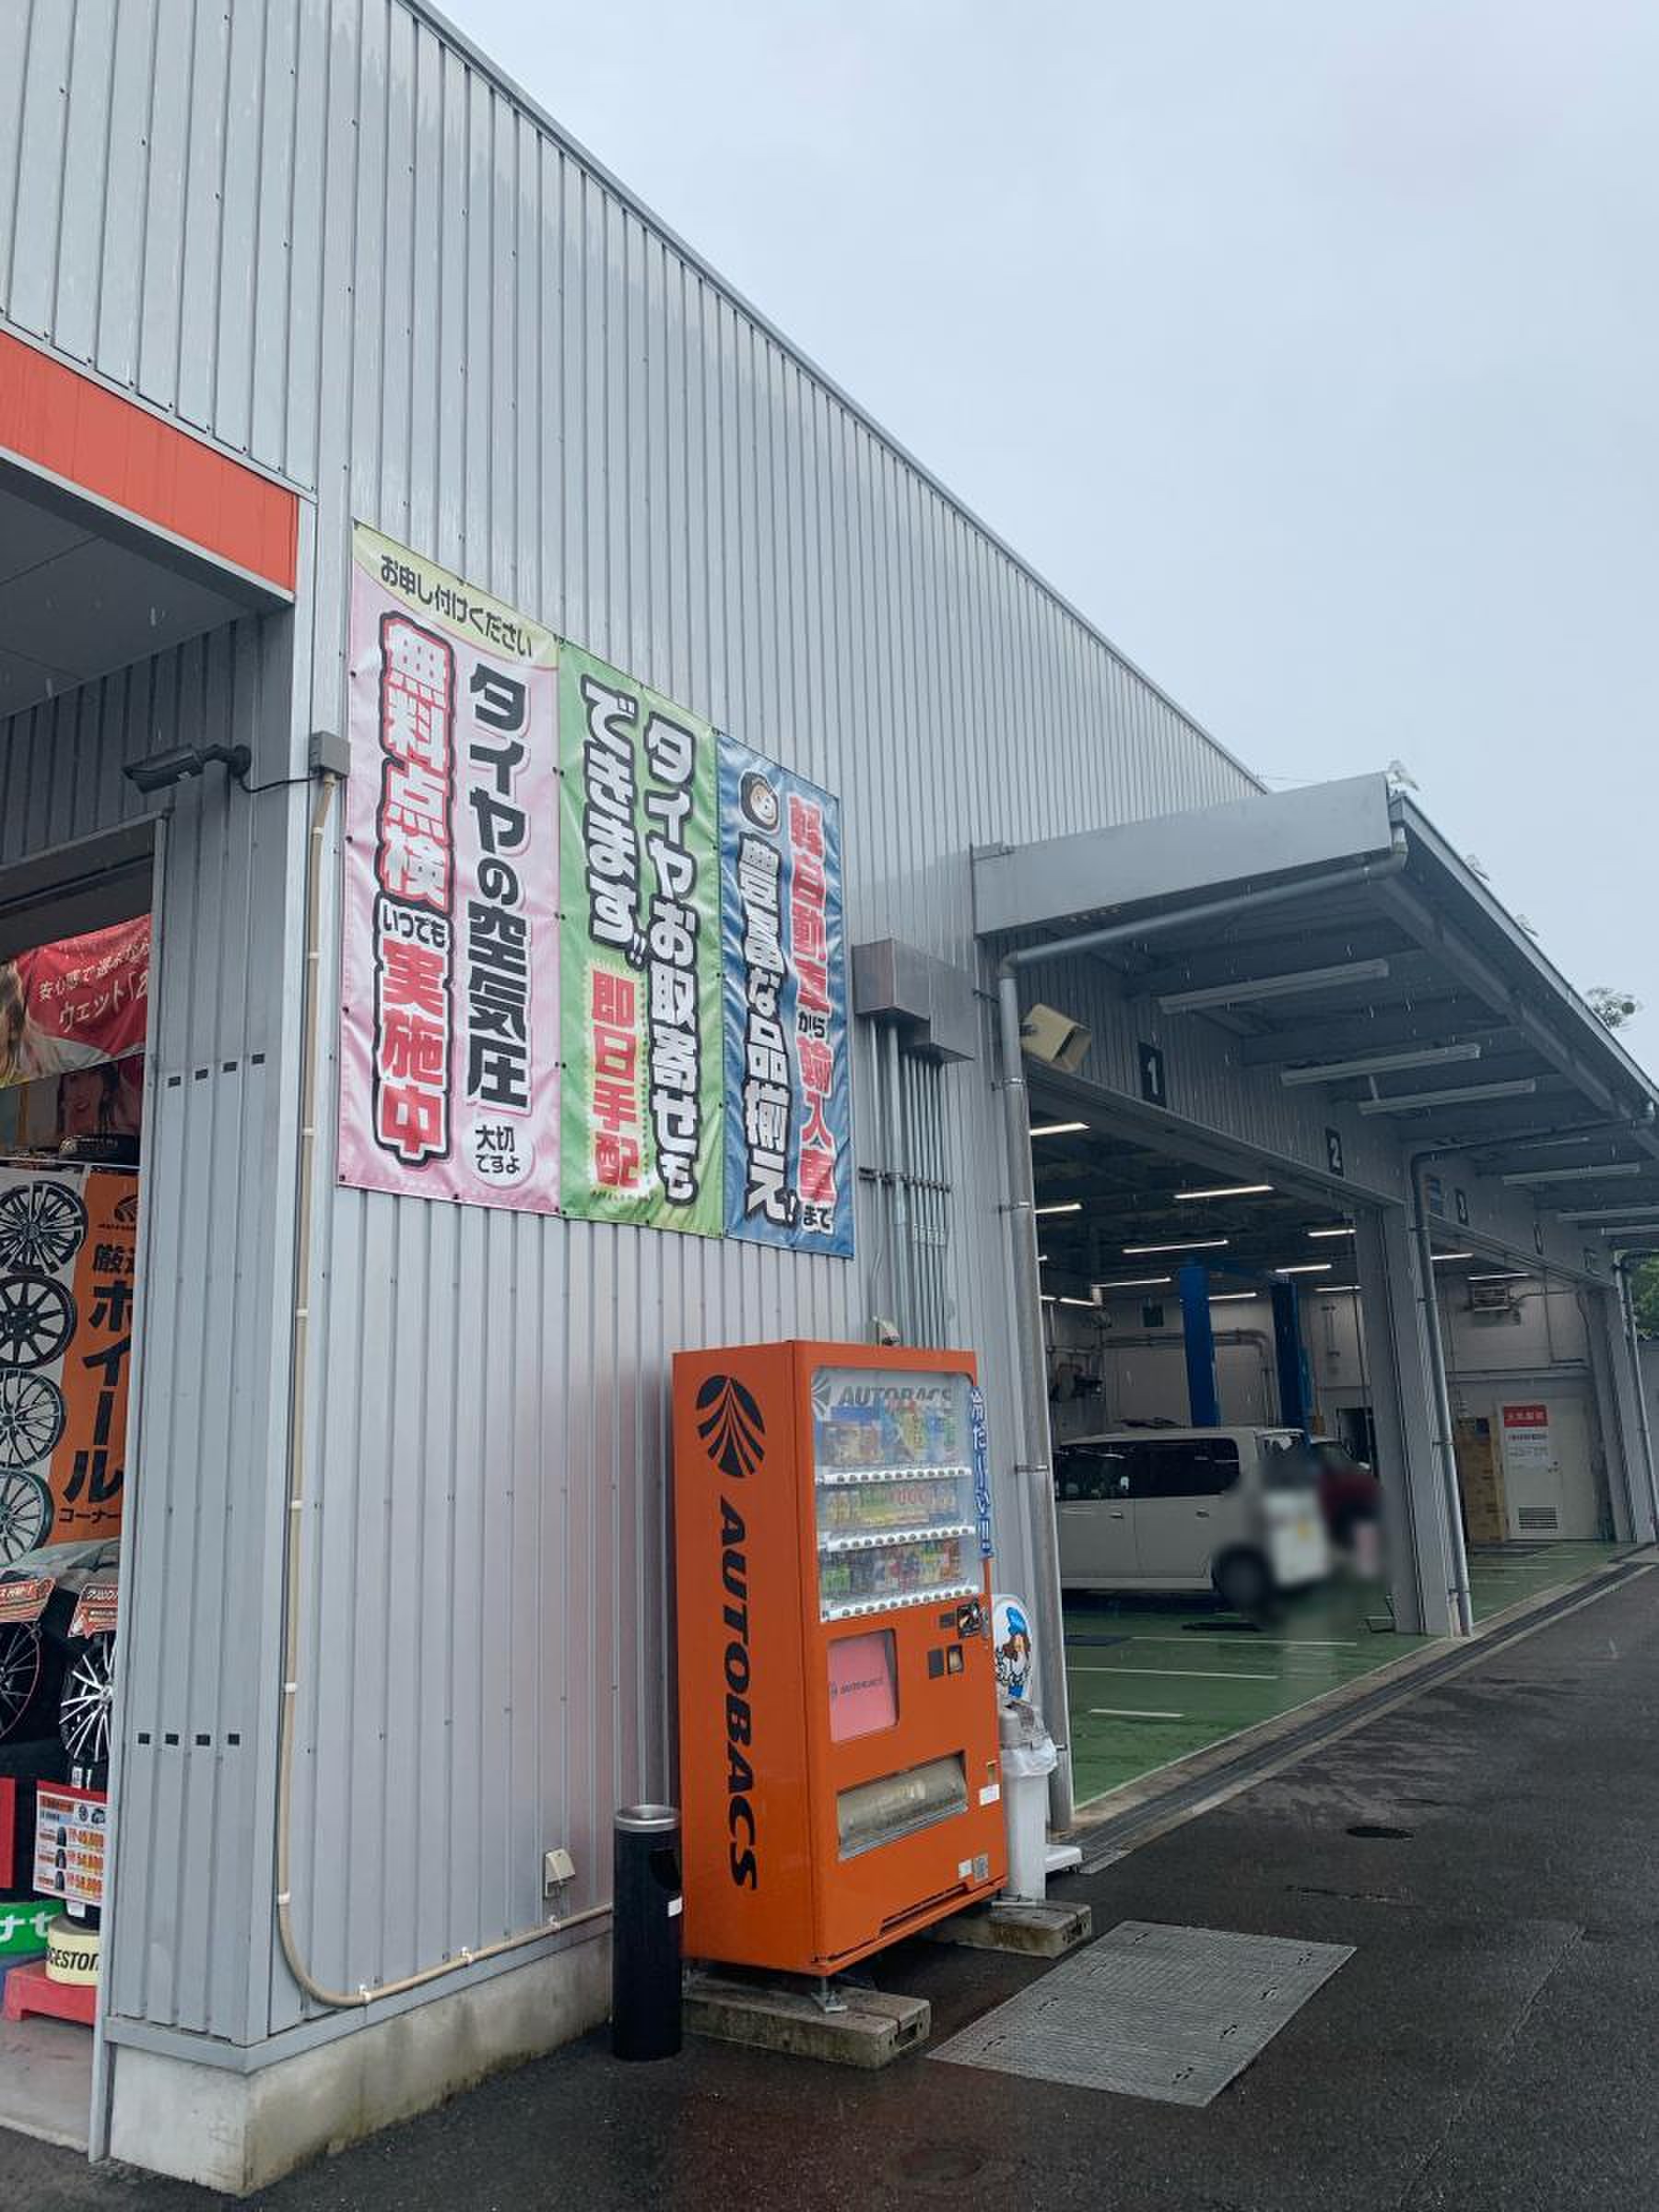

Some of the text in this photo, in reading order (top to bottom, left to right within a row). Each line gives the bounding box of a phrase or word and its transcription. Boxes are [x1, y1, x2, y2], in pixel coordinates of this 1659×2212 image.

[380, 555, 533, 657] お申し付けください
[380, 611, 453, 912] 無料点検
[382, 903, 446, 948] いつでも
[468, 663, 528, 1109] タイヤの空気圧
[645, 711, 700, 1206] タイヤお取寄せも
[375, 935, 452, 1165] 実施中
[798, 1012, 827, 1039] から
[1147, 1056, 1159, 1096] 1
[593, 970, 641, 1190] 即日手配
[475, 1124, 516, 1153] 大切
[475, 1151, 521, 1175] ですよ
[1329, 1136, 1342, 1170] 2
[802, 1204, 833, 1230] まで
[64, 1280, 134, 1504] ホイール
[719, 1494, 759, 1892] AUTOBACS
